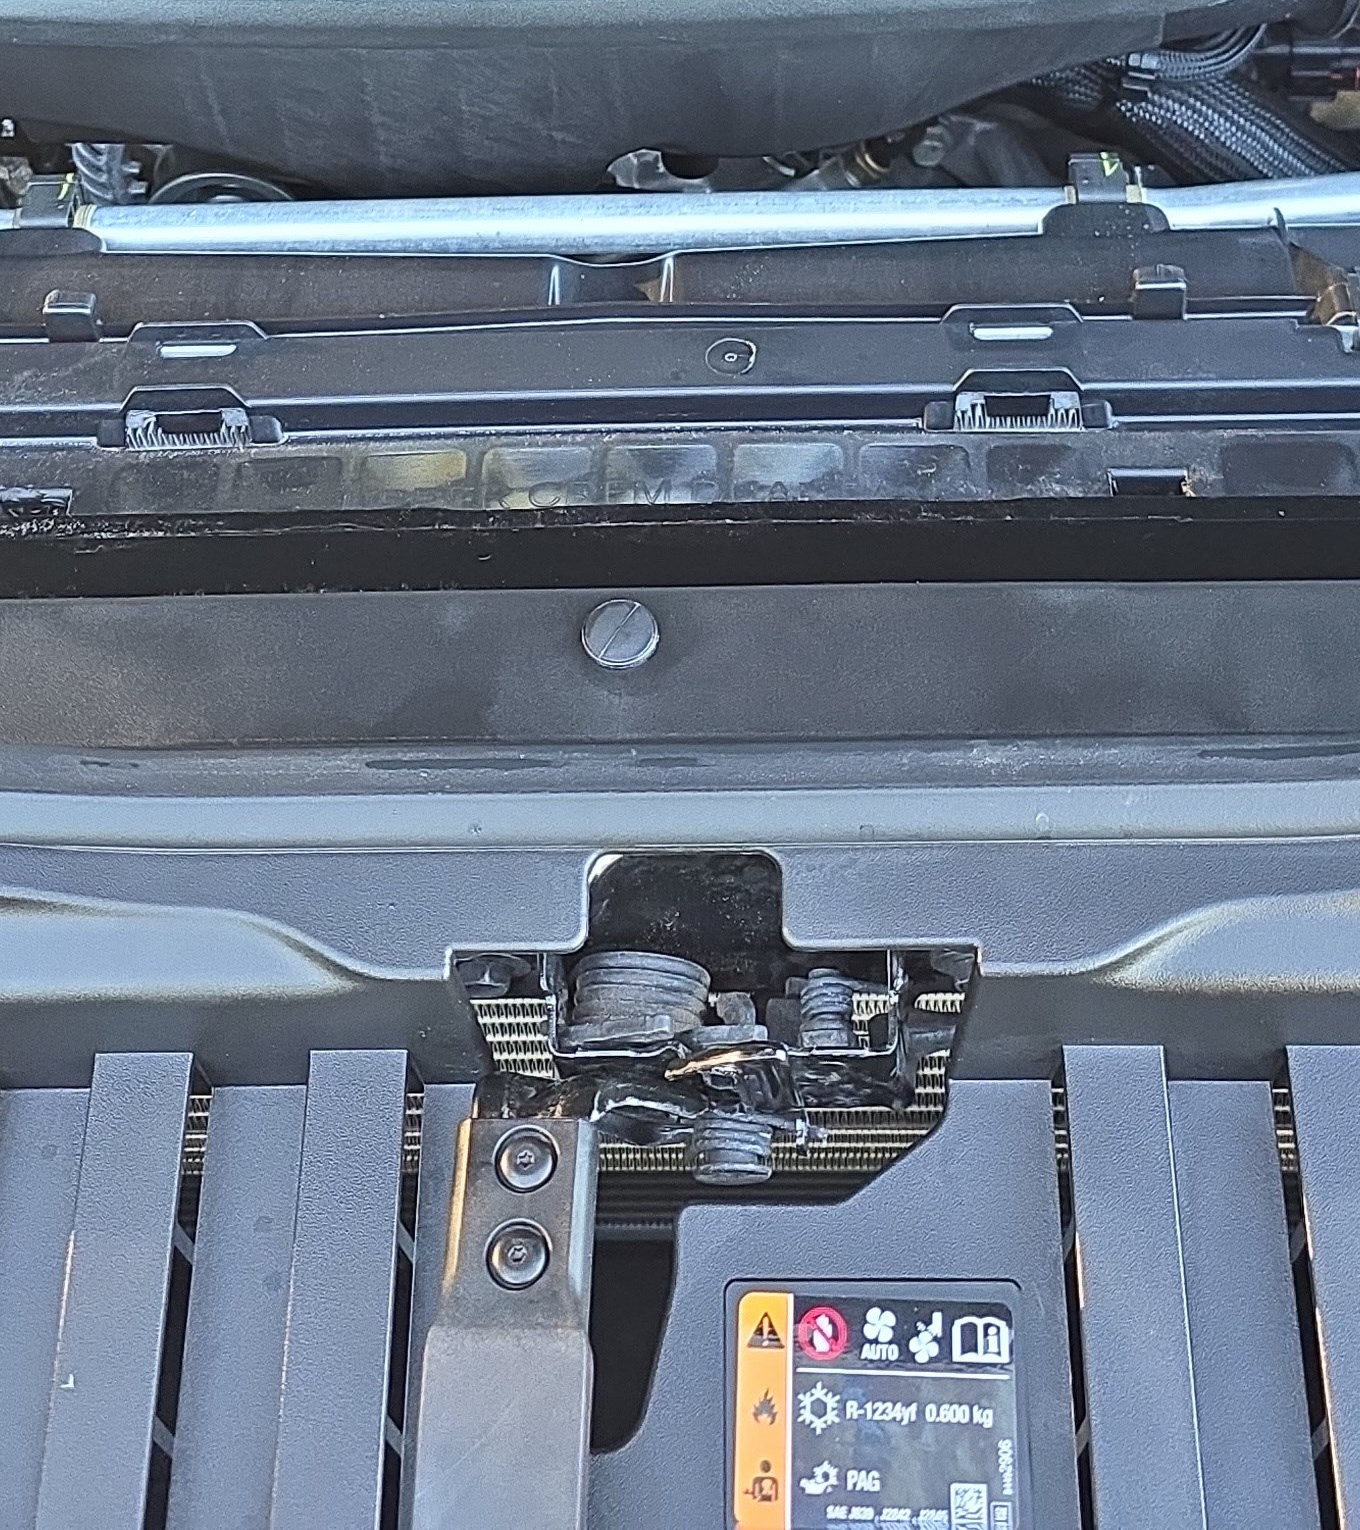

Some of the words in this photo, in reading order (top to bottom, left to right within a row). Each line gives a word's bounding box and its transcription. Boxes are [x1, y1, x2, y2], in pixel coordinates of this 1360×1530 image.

[860, 1342, 900, 1362] AUTO
[845, 1400, 918, 1426] R-1234yf
[924, 1403, 970, 1424] 0.600
[972, 1404, 994, 1428] kg
[846, 1469, 881, 1492] PAG
